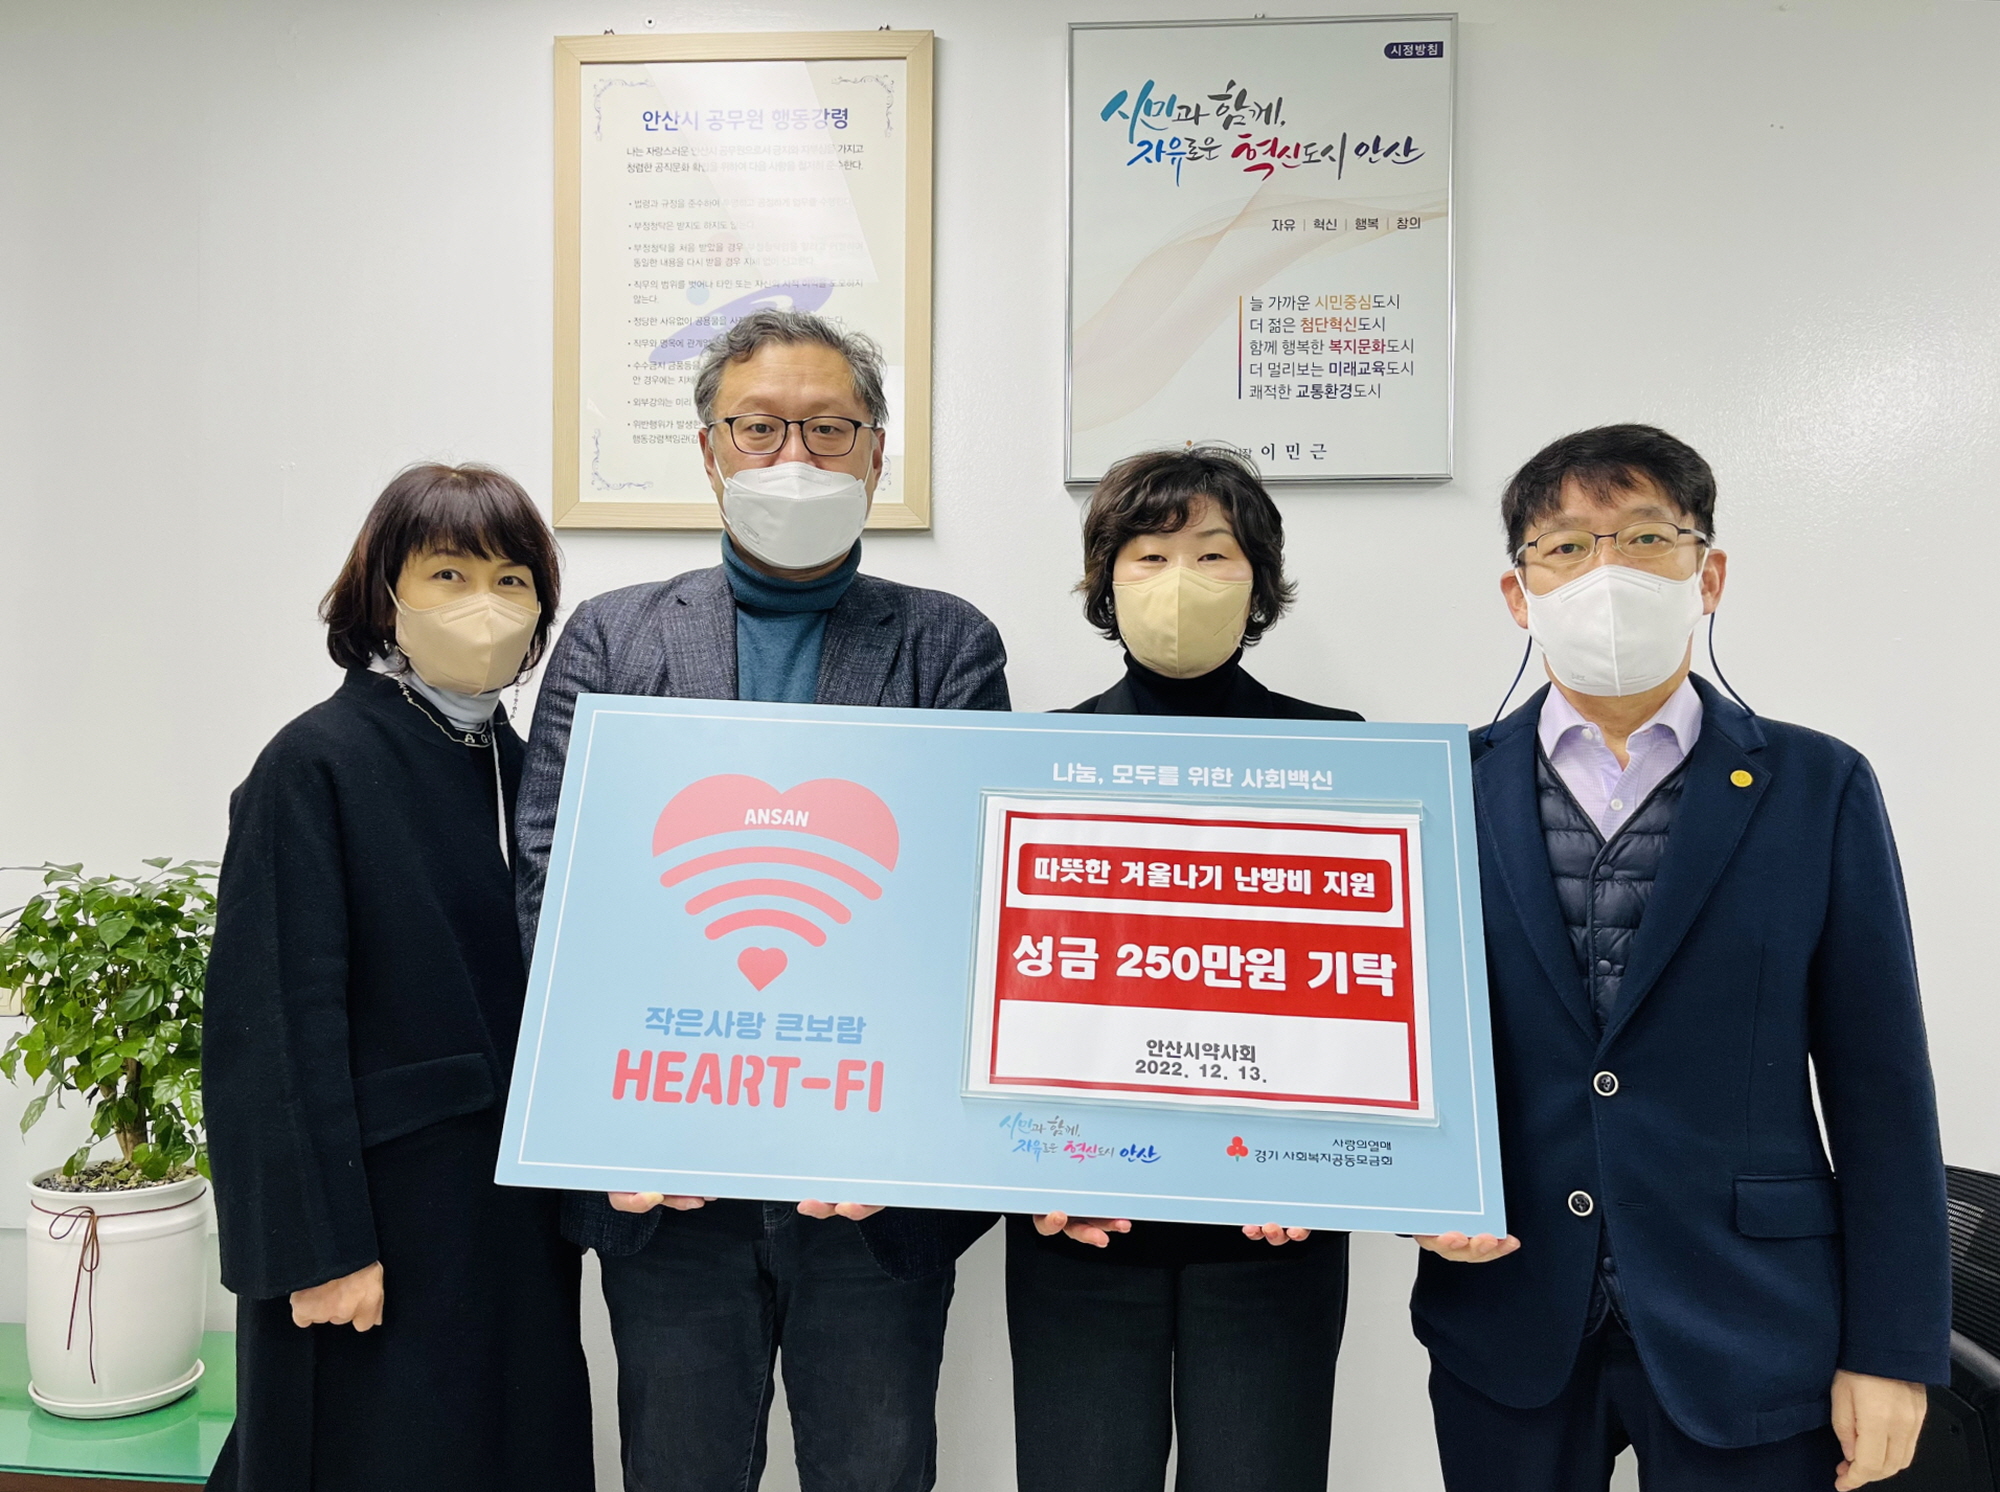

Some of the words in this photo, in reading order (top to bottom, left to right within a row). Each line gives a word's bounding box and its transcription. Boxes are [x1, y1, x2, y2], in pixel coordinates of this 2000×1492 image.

[1390, 42, 1439, 58] 시정방침
[642, 109, 700, 132] 안산시
[705, 108, 764, 132] 공무원
[771, 106, 849, 131] 행동강령
[1100, 79, 1210, 144] 시민과
[626, 146, 644, 157] 나는
[645, 145, 689, 157] 자랑스러운
[837, 143, 865, 154] 가지고
[1126, 135, 1223, 187] 자유로운
[1230, 131, 1347, 182] 혁신도시
[1353, 134, 1426, 166] 안산
[626, 162, 653, 173] 청렴한
[655, 161, 690, 173] 공직문화
[633, 198, 659, 209] 법령과
[660, 198, 686, 209] 규정을
[687, 197, 720, 209] 준수하여
[676, 220, 702, 231] 받지도
[703, 220, 728, 230] 하지도
[1271, 218, 1297, 232] 자유
[1313, 218, 1338, 232] 혁신
[1354, 217, 1380, 231] 행복
[1396, 216, 1422, 231] 창의
[679, 242, 696, 253] 처음
[698, 242, 724, 253] 받았을
[727, 242, 745, 253] 경우
[633, 257, 658, 268] 동일한
[660, 257, 685, 268] 내용을
[686, 257, 704, 267] 다시
[705, 257, 723, 267] 받을
[725, 257, 741, 268] 경우
[633, 279, 659, 290] 직무의
[660, 279, 686, 290] 범위를
[688, 279, 714, 290] 벗어나
[715, 279, 733, 290] 타인
[735, 279, 752, 289] 또는
[1249, 296, 1264, 311] 늘
[1267, 295, 1311, 311] 가까운
[1314, 294, 1401, 311] 시민중심도시
[633, 316, 658, 327] 정당한
[659, 316, 693, 327] 사유없이
[1249, 318, 1264, 333] 더
[1267, 317, 1297, 333] 젊은
[1299, 316, 1387, 333] 첨단혁신도시
[633, 338, 658, 349] 직무와
[659, 338, 685, 349] 명목에
[1248, 340, 1279, 356] 함께
[1281, 339, 1325, 355] 행복한
[1327, 338, 1415, 355] 복지문화도시
[1249, 362, 1263, 377] 더
[1267, 361, 1325, 378] 멀리보는
[1327, 360, 1415, 377] 미래교육도시
[643, 375, 676, 386] 경우에는
[1248, 383, 1292, 401] 쾌적한
[1295, 382, 1382, 400] 교통환경도시
[632, 397, 674, 407] 외부강의는
[675, 397, 692, 407] 미리
[632, 419, 675, 430] 위반행위가
[1052, 762, 1104, 785] 나눔,
[1111, 764, 1180, 787] 모두를
[1187, 766, 1233, 788] 위한
[1241, 768, 1334, 792] 사회백신
[744, 808, 810, 828] ANSAN
[1034, 857, 1112, 885] 따뜻한
[1120, 861, 1223, 891] 겨울나기
[1234, 867, 1312, 896] 난방비
[1322, 870, 1376, 899] 지원
[1012, 934, 1100, 981] 성금
[1115, 943, 1287, 991] 250만원
[1307, 950, 1397, 997] 기탁
[644, 1006, 767, 1040] 작은사랑
[774, 1012, 867, 1045] 큰보람
[1145, 1039, 1257, 1064] 안산시약사회
[611, 1048, 885, 1113] HEART-FI
[1134, 1059, 1190, 1079] 2022.
[1199, 1063, 1229, 1081] 12.
[1238, 1065, 1268, 1084] 13.
[999, 1111, 1047, 1140] 시민과
[1011, 1138, 1059, 1163] 자유로운
[1063, 1140, 1115, 1164] 혁신도시
[1119, 1143, 1162, 1164] 안산
[1254, 1149, 1279, 1163] 경기
[1282, 1150, 1393, 1168] 사회복지공동모금회
